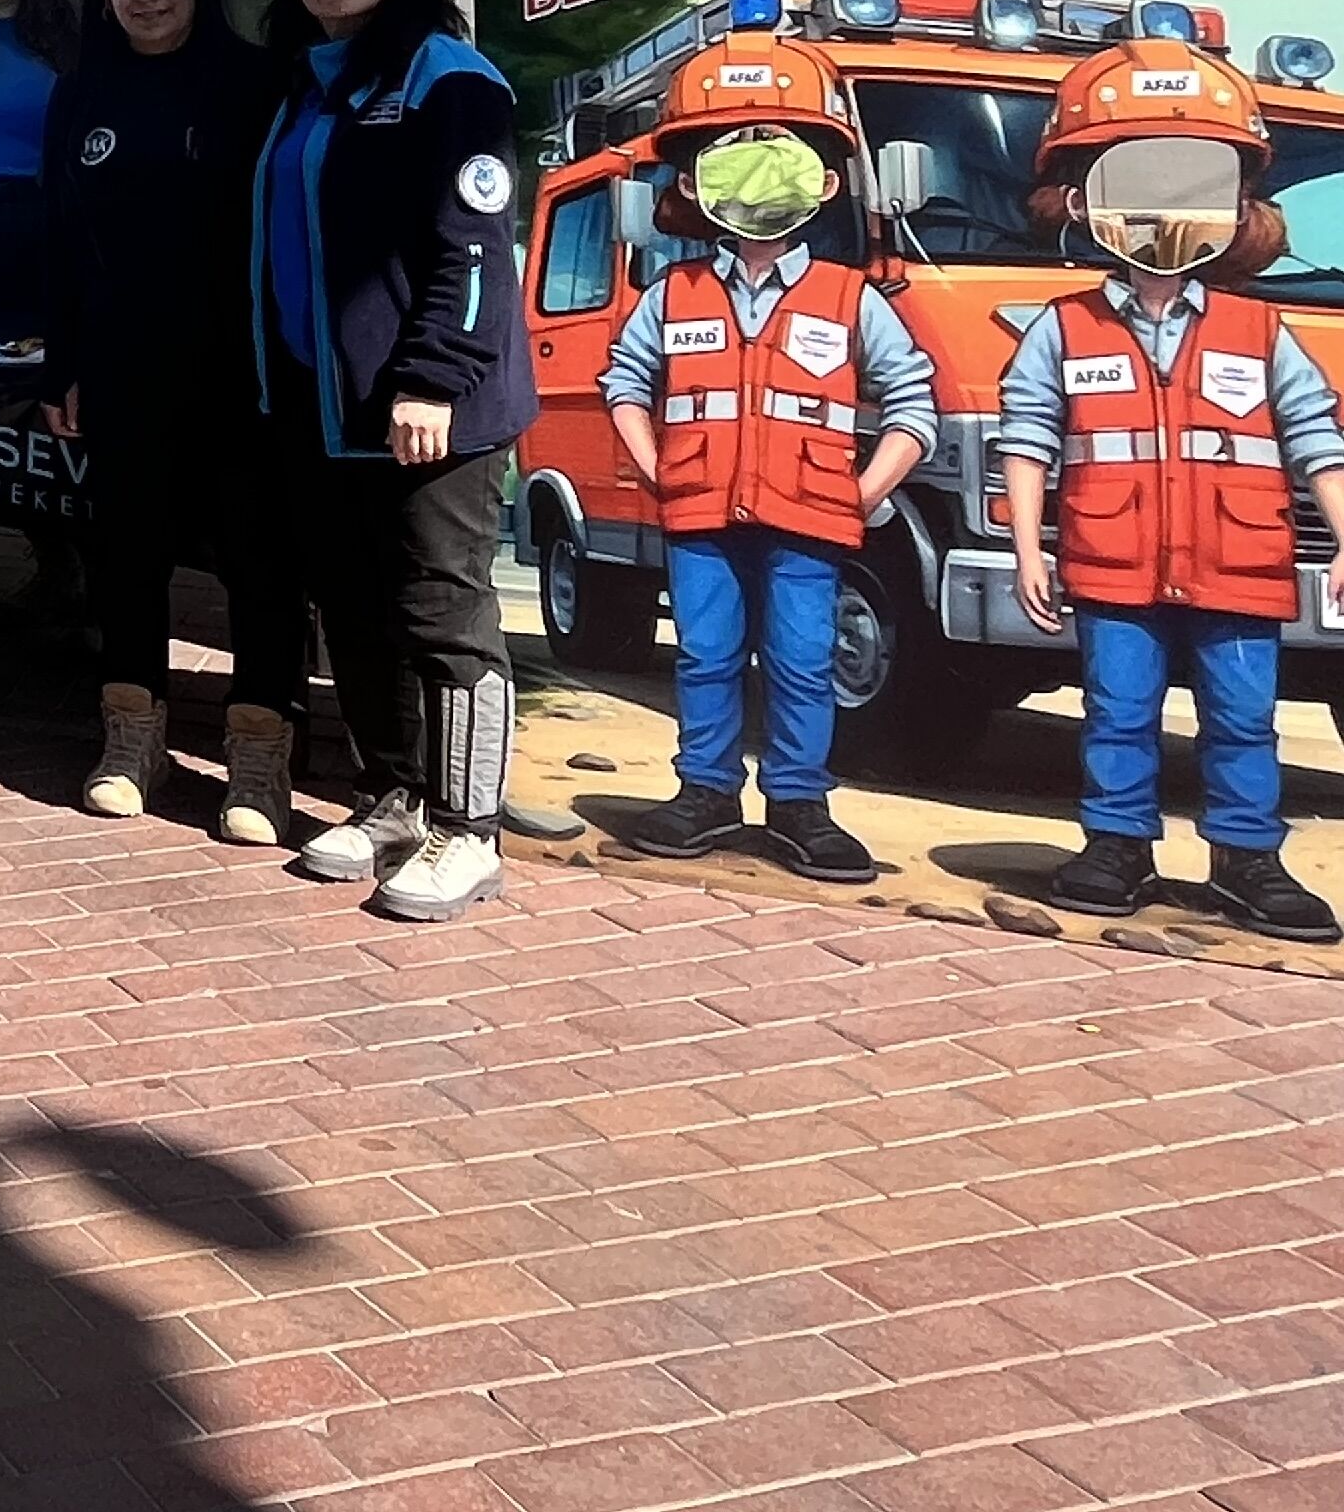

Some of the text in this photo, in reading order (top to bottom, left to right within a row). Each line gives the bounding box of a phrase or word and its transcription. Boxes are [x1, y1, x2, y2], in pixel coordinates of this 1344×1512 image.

[1143, 79, 1187, 92] AFAD
[672, 330, 718, 346] AFAD
[1074, 368, 1123, 385] AFAD
